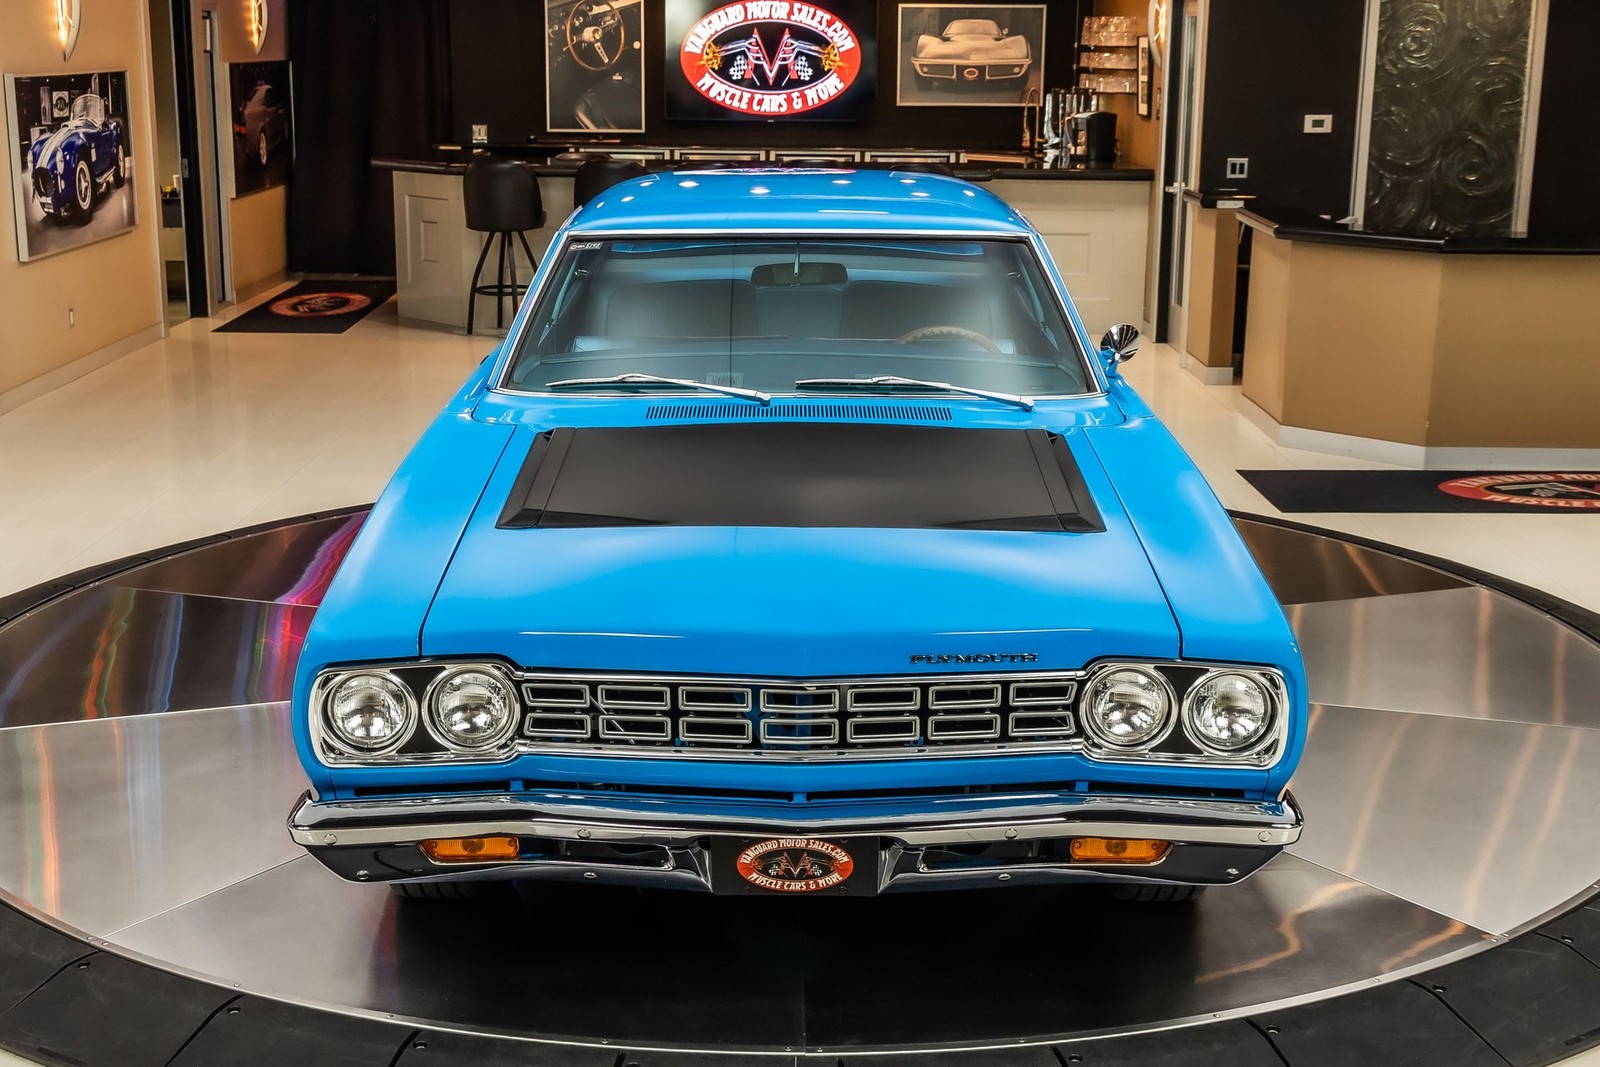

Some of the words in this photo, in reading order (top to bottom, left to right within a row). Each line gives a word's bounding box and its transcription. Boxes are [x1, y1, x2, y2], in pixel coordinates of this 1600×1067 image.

[685, 3, 746, 54] VANGUARD
[745, 1, 791, 21] MOTOR
[791, 2, 856, 53] SALES.COM
[696, 72, 752, 111] MUSCLE
[752, 94, 789, 113] CARS
[792, 92, 803, 110] &
[804, 73, 845, 106] MORE
[1482, 495, 1585, 507] MUSCLE
[909, 653, 1039, 665] PLYMOUTH
[740, 840, 778, 863] VANGUARD
[779, 838, 807, 849] MOTOR
[808, 839, 849, 864] SALES.COM
[748, 873, 784, 889] MUSCLE
[783, 880, 807, 891] CARS
[809, 879, 816, 889] &
[818, 872, 843, 888] MORE
